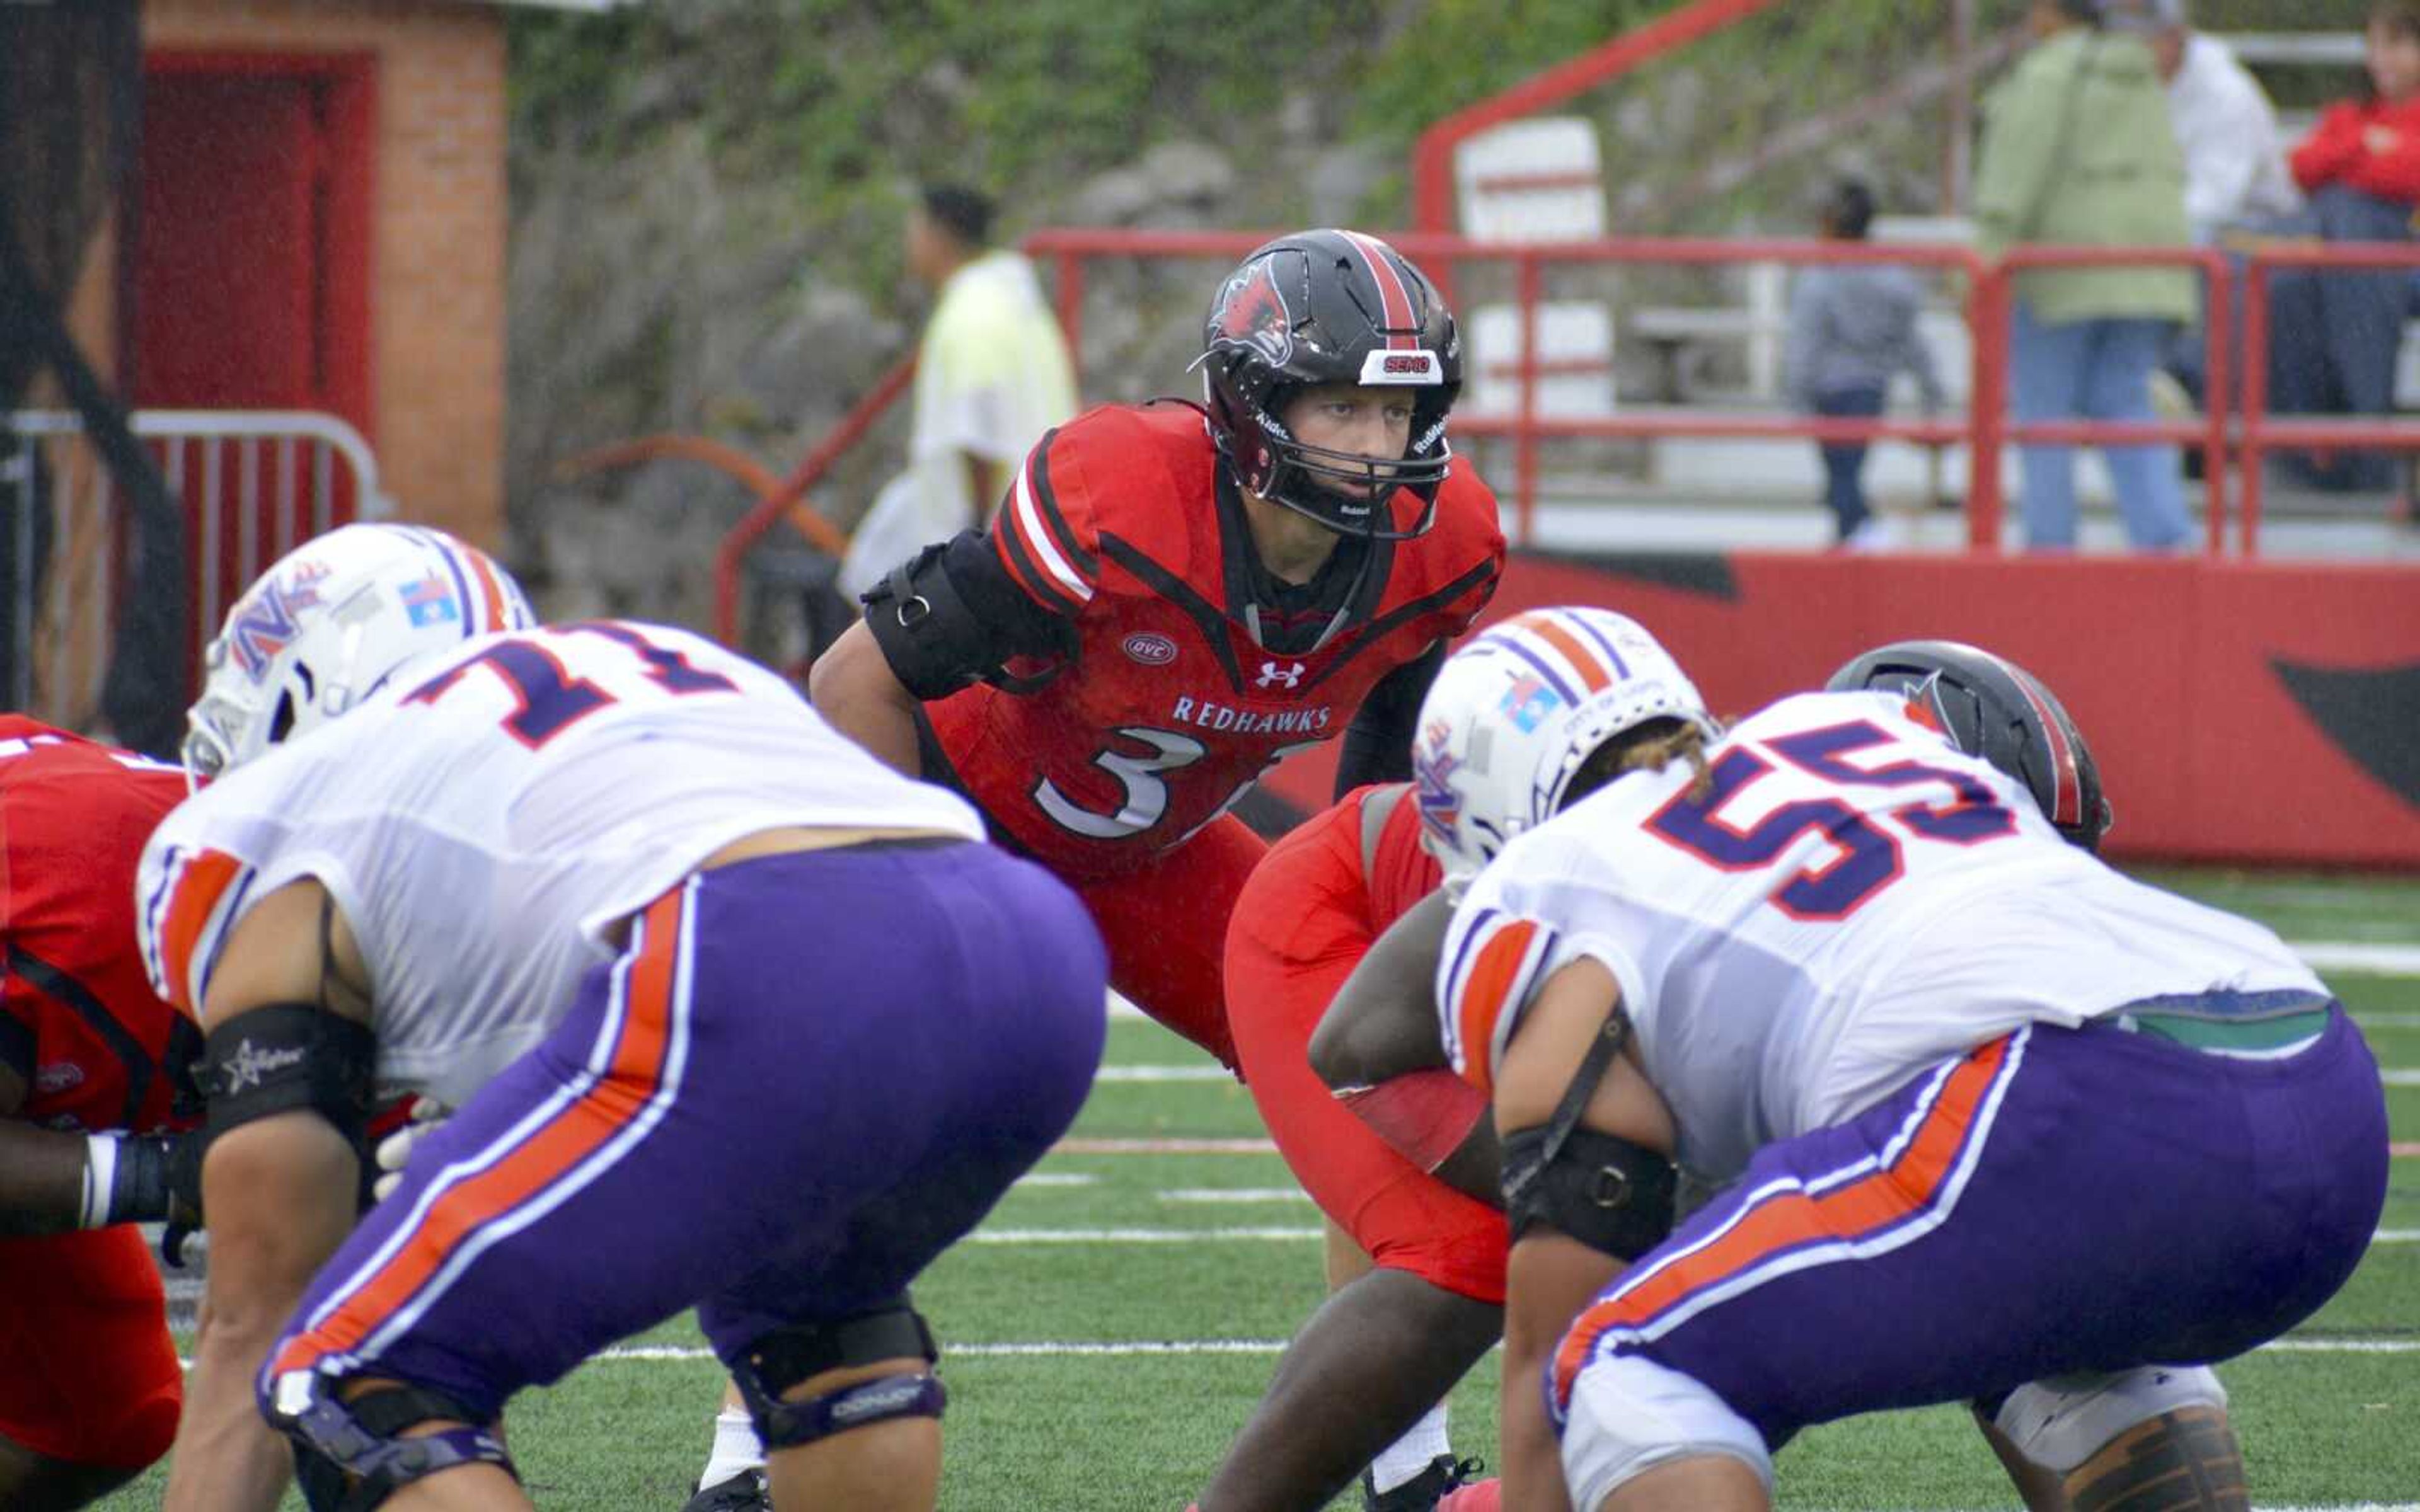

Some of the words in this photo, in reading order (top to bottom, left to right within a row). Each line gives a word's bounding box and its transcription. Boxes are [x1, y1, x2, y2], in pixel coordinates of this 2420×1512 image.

[1384, 355, 1430, 373] SEMO
[1132, 639, 1170, 657] OVC
[1173, 696, 1331, 734] REDHAWKS
[1639, 719, 2020, 922] 55
